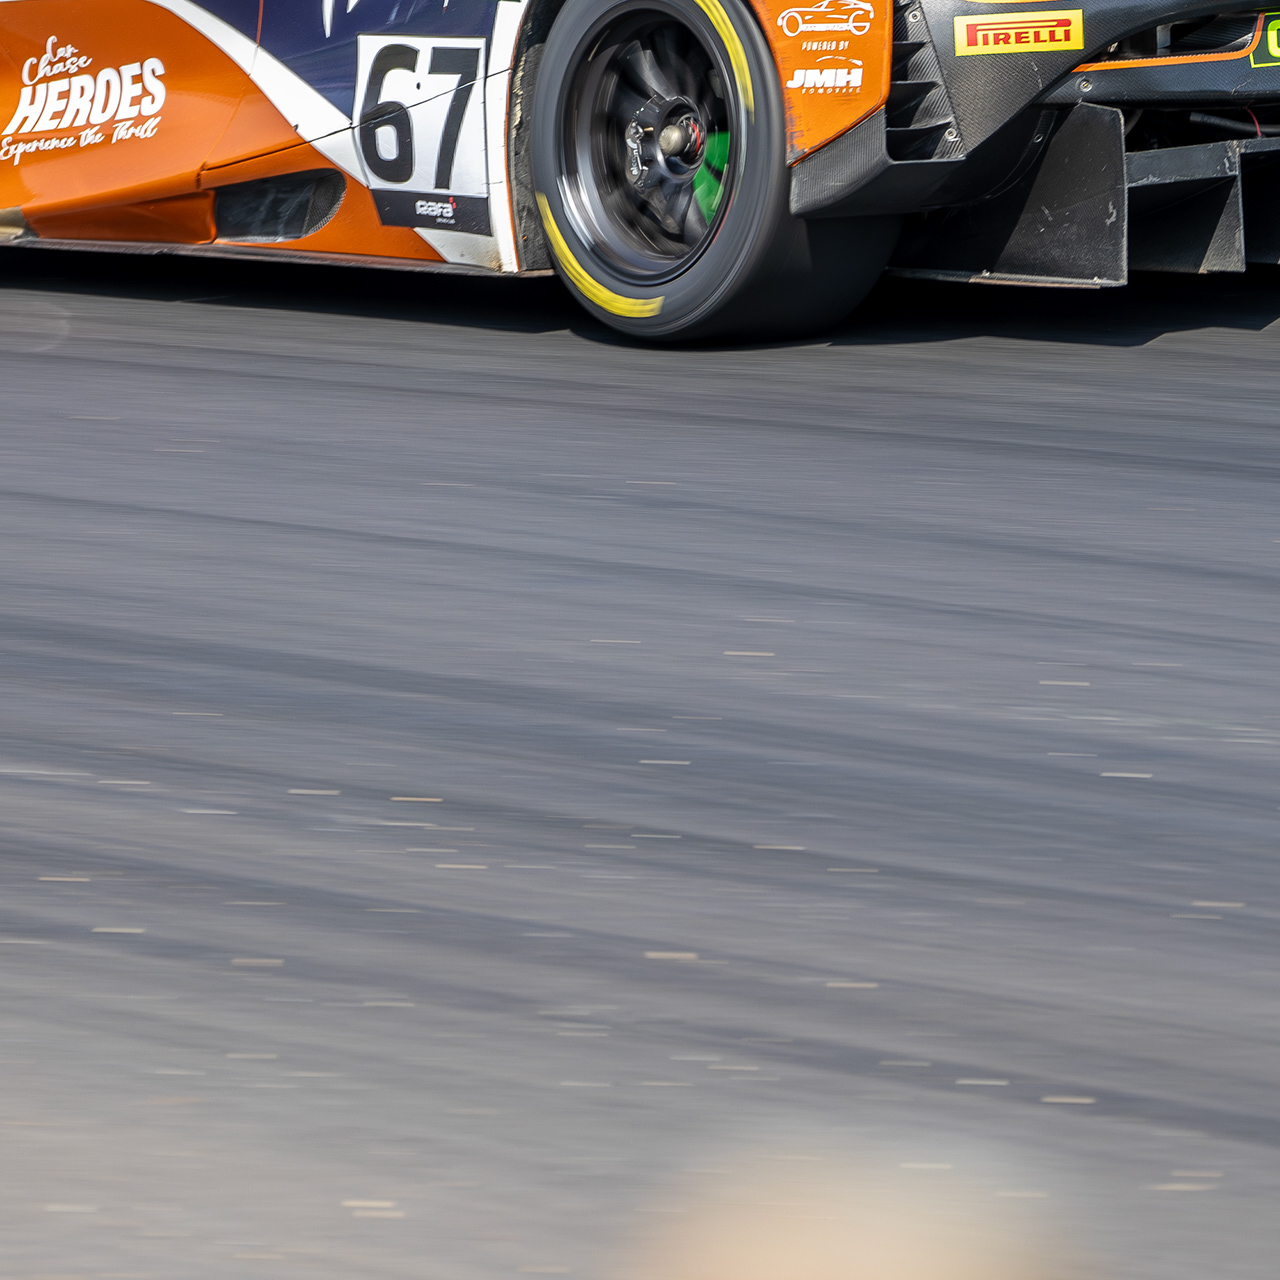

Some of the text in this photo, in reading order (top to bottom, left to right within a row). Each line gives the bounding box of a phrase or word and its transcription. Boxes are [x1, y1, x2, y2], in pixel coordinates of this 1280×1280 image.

[966, 19, 1072, 47] PIRELLI
[46, 35, 79, 63] Car
[22, 53, 93, 86] Chase
[786, 68, 863, 88] JMH
[1, 58, 166, 136] HEROES
[360, 43, 481, 190] 67
